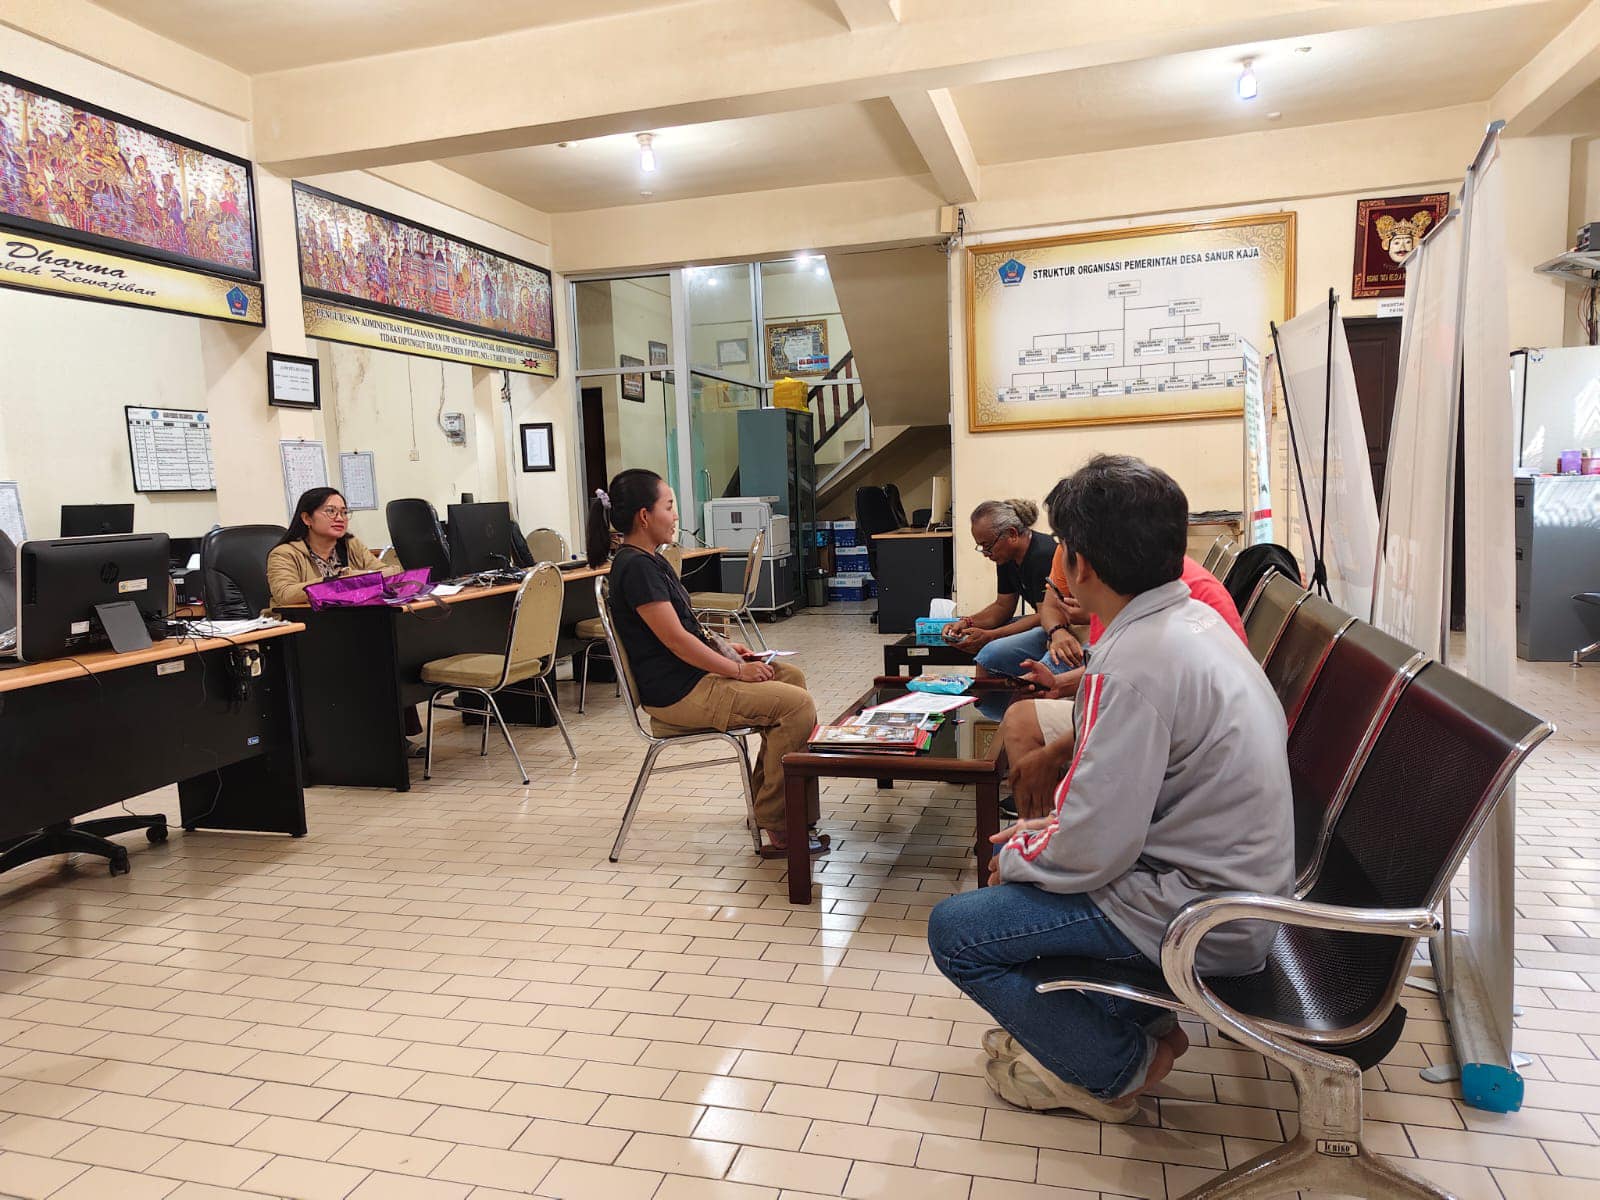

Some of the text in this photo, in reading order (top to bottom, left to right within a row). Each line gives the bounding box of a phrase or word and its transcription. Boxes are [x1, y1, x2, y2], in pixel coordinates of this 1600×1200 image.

[6, 241, 128, 278] Dharma
[1032, 247, 1260, 280] STRUKTUR ORGANISASI PEMERINTAH DESA SANUR KAJA
[0, 261, 157, 297] lah Kewajiban
[361, 318, 403, 335] ADMINISTRASI
[380, 333, 398, 344] TIDAK
